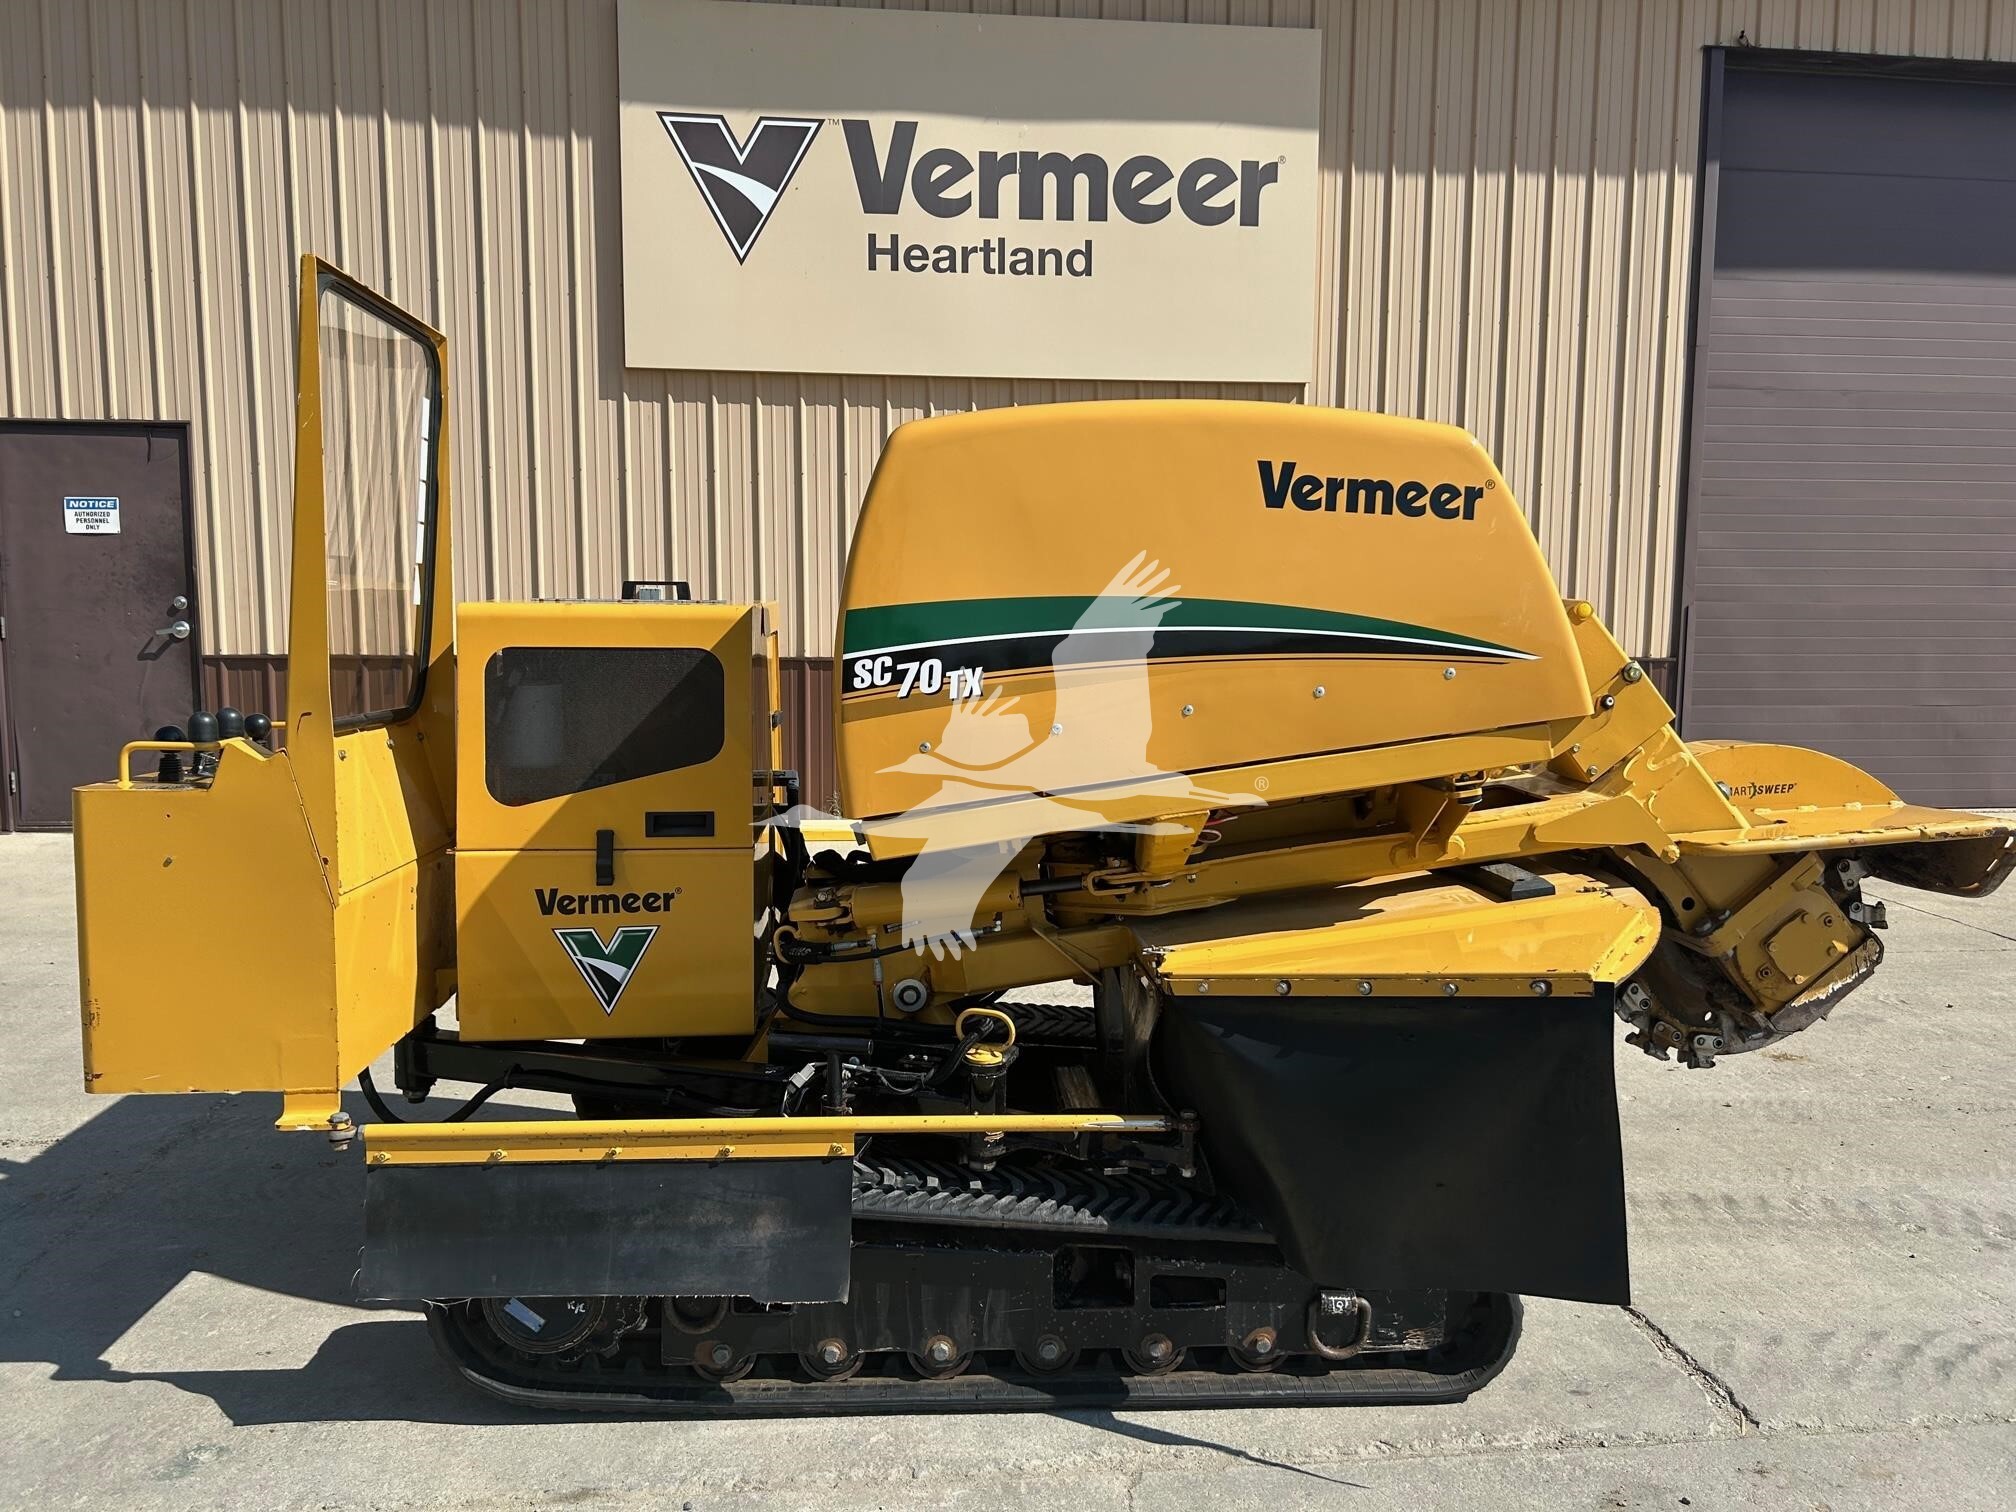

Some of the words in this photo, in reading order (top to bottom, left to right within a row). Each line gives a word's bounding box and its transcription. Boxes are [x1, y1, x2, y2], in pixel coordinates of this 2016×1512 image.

[842, 119, 1279, 227] Vermeer
[867, 233, 1093, 277] Heartland
[69, 500, 114, 508] NOTICE
[1257, 460, 1484, 520] Vermeer
[853, 656, 893, 689] SC
[896, 658, 943, 698] 70
[945, 666, 984, 700] TX
[1757, 783, 1794, 795] SWEEP
[535, 888, 675, 916] Vermeer
